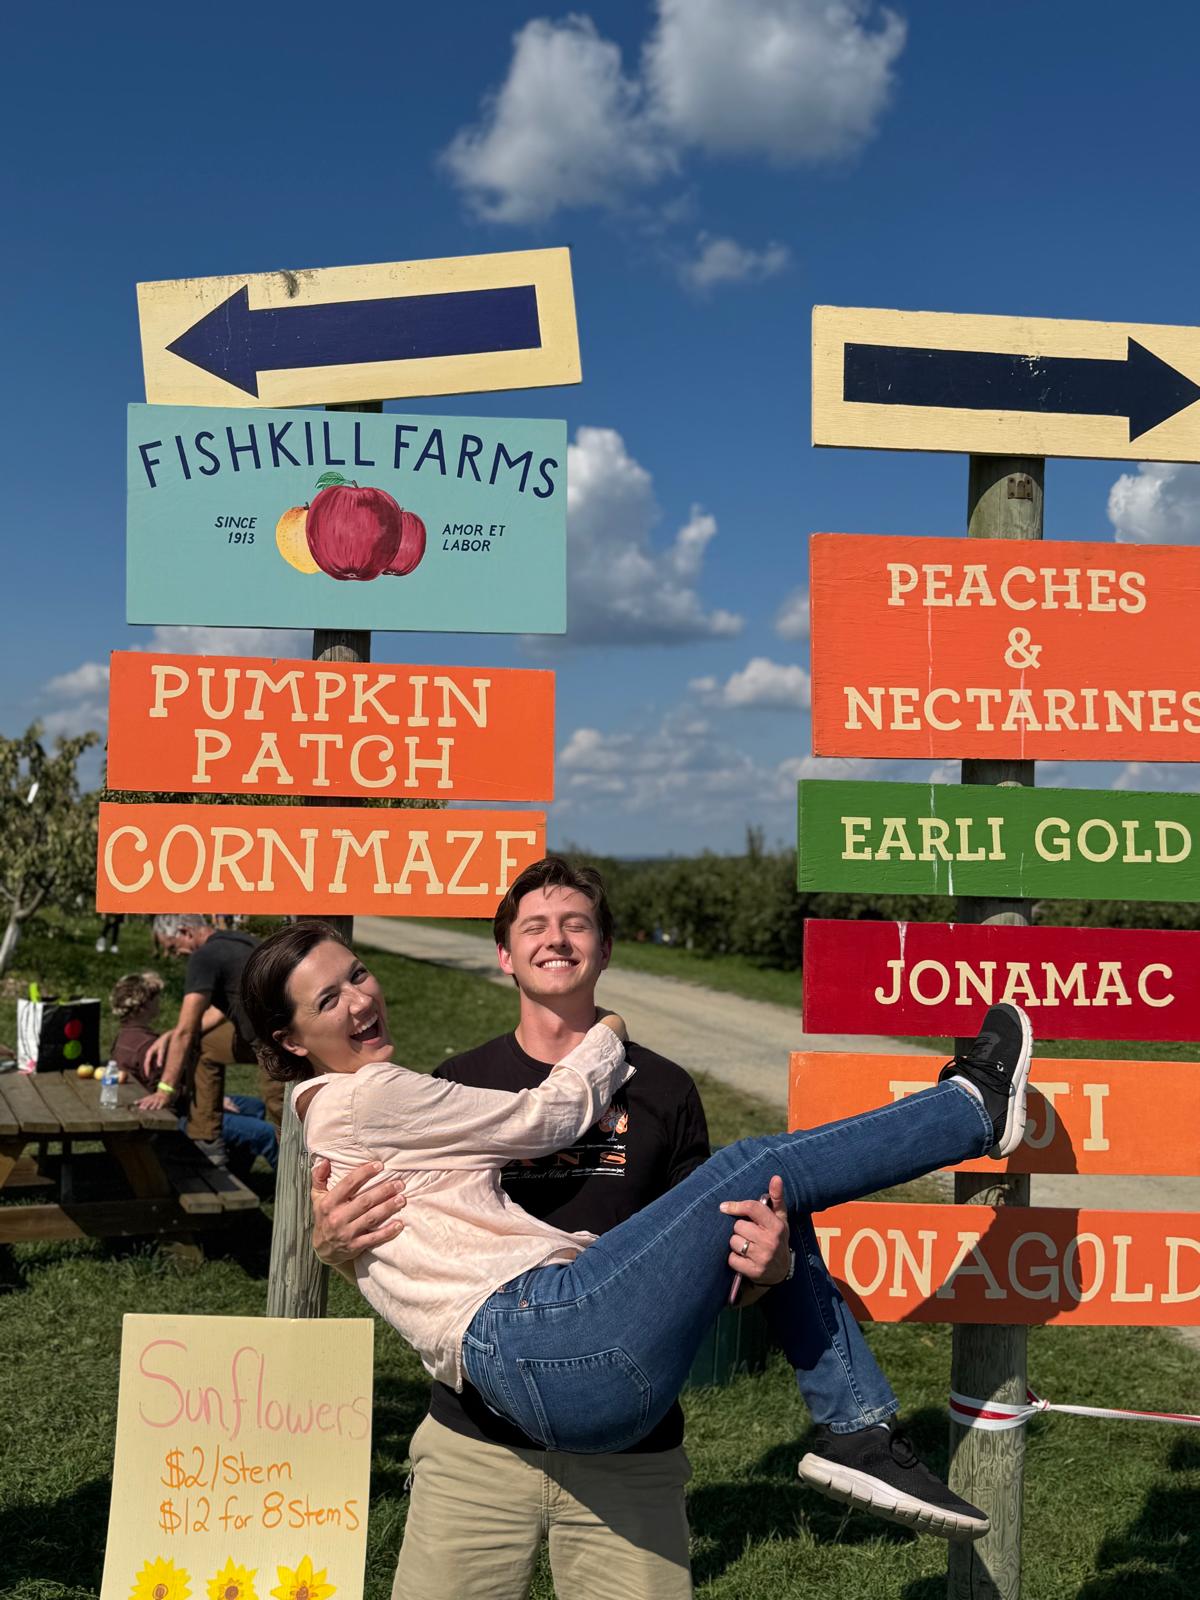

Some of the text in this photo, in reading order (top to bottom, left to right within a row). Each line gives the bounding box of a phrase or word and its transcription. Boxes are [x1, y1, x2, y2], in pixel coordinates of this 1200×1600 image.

[137, 420, 559, 499] FISHKILL FARMS
[214, 515, 258, 529] SINCE
[227, 531, 256, 545] 1913
[442, 523, 507, 538] AMOR ET
[442, 539, 492, 552] LABOR
[886, 562, 1147, 614] PEACHES
[1003, 626, 1043, 669] &
[149, 665, 492, 728] PUMPKIN
[843, 685, 1200, 734] NECTARINES
[191, 728, 456, 789] PATCH
[104, 824, 319, 894] CORN
[840, 816, 1192, 864] EARLI GOLD
[874, 958, 1176, 1007] JONAMAC
[888, 1080, 1110, 1152] JI
[138, 1339, 370, 1441] Sunflowers
[159, 1496, 210, 1535] $12
[219, 1495, 253, 1532] for
